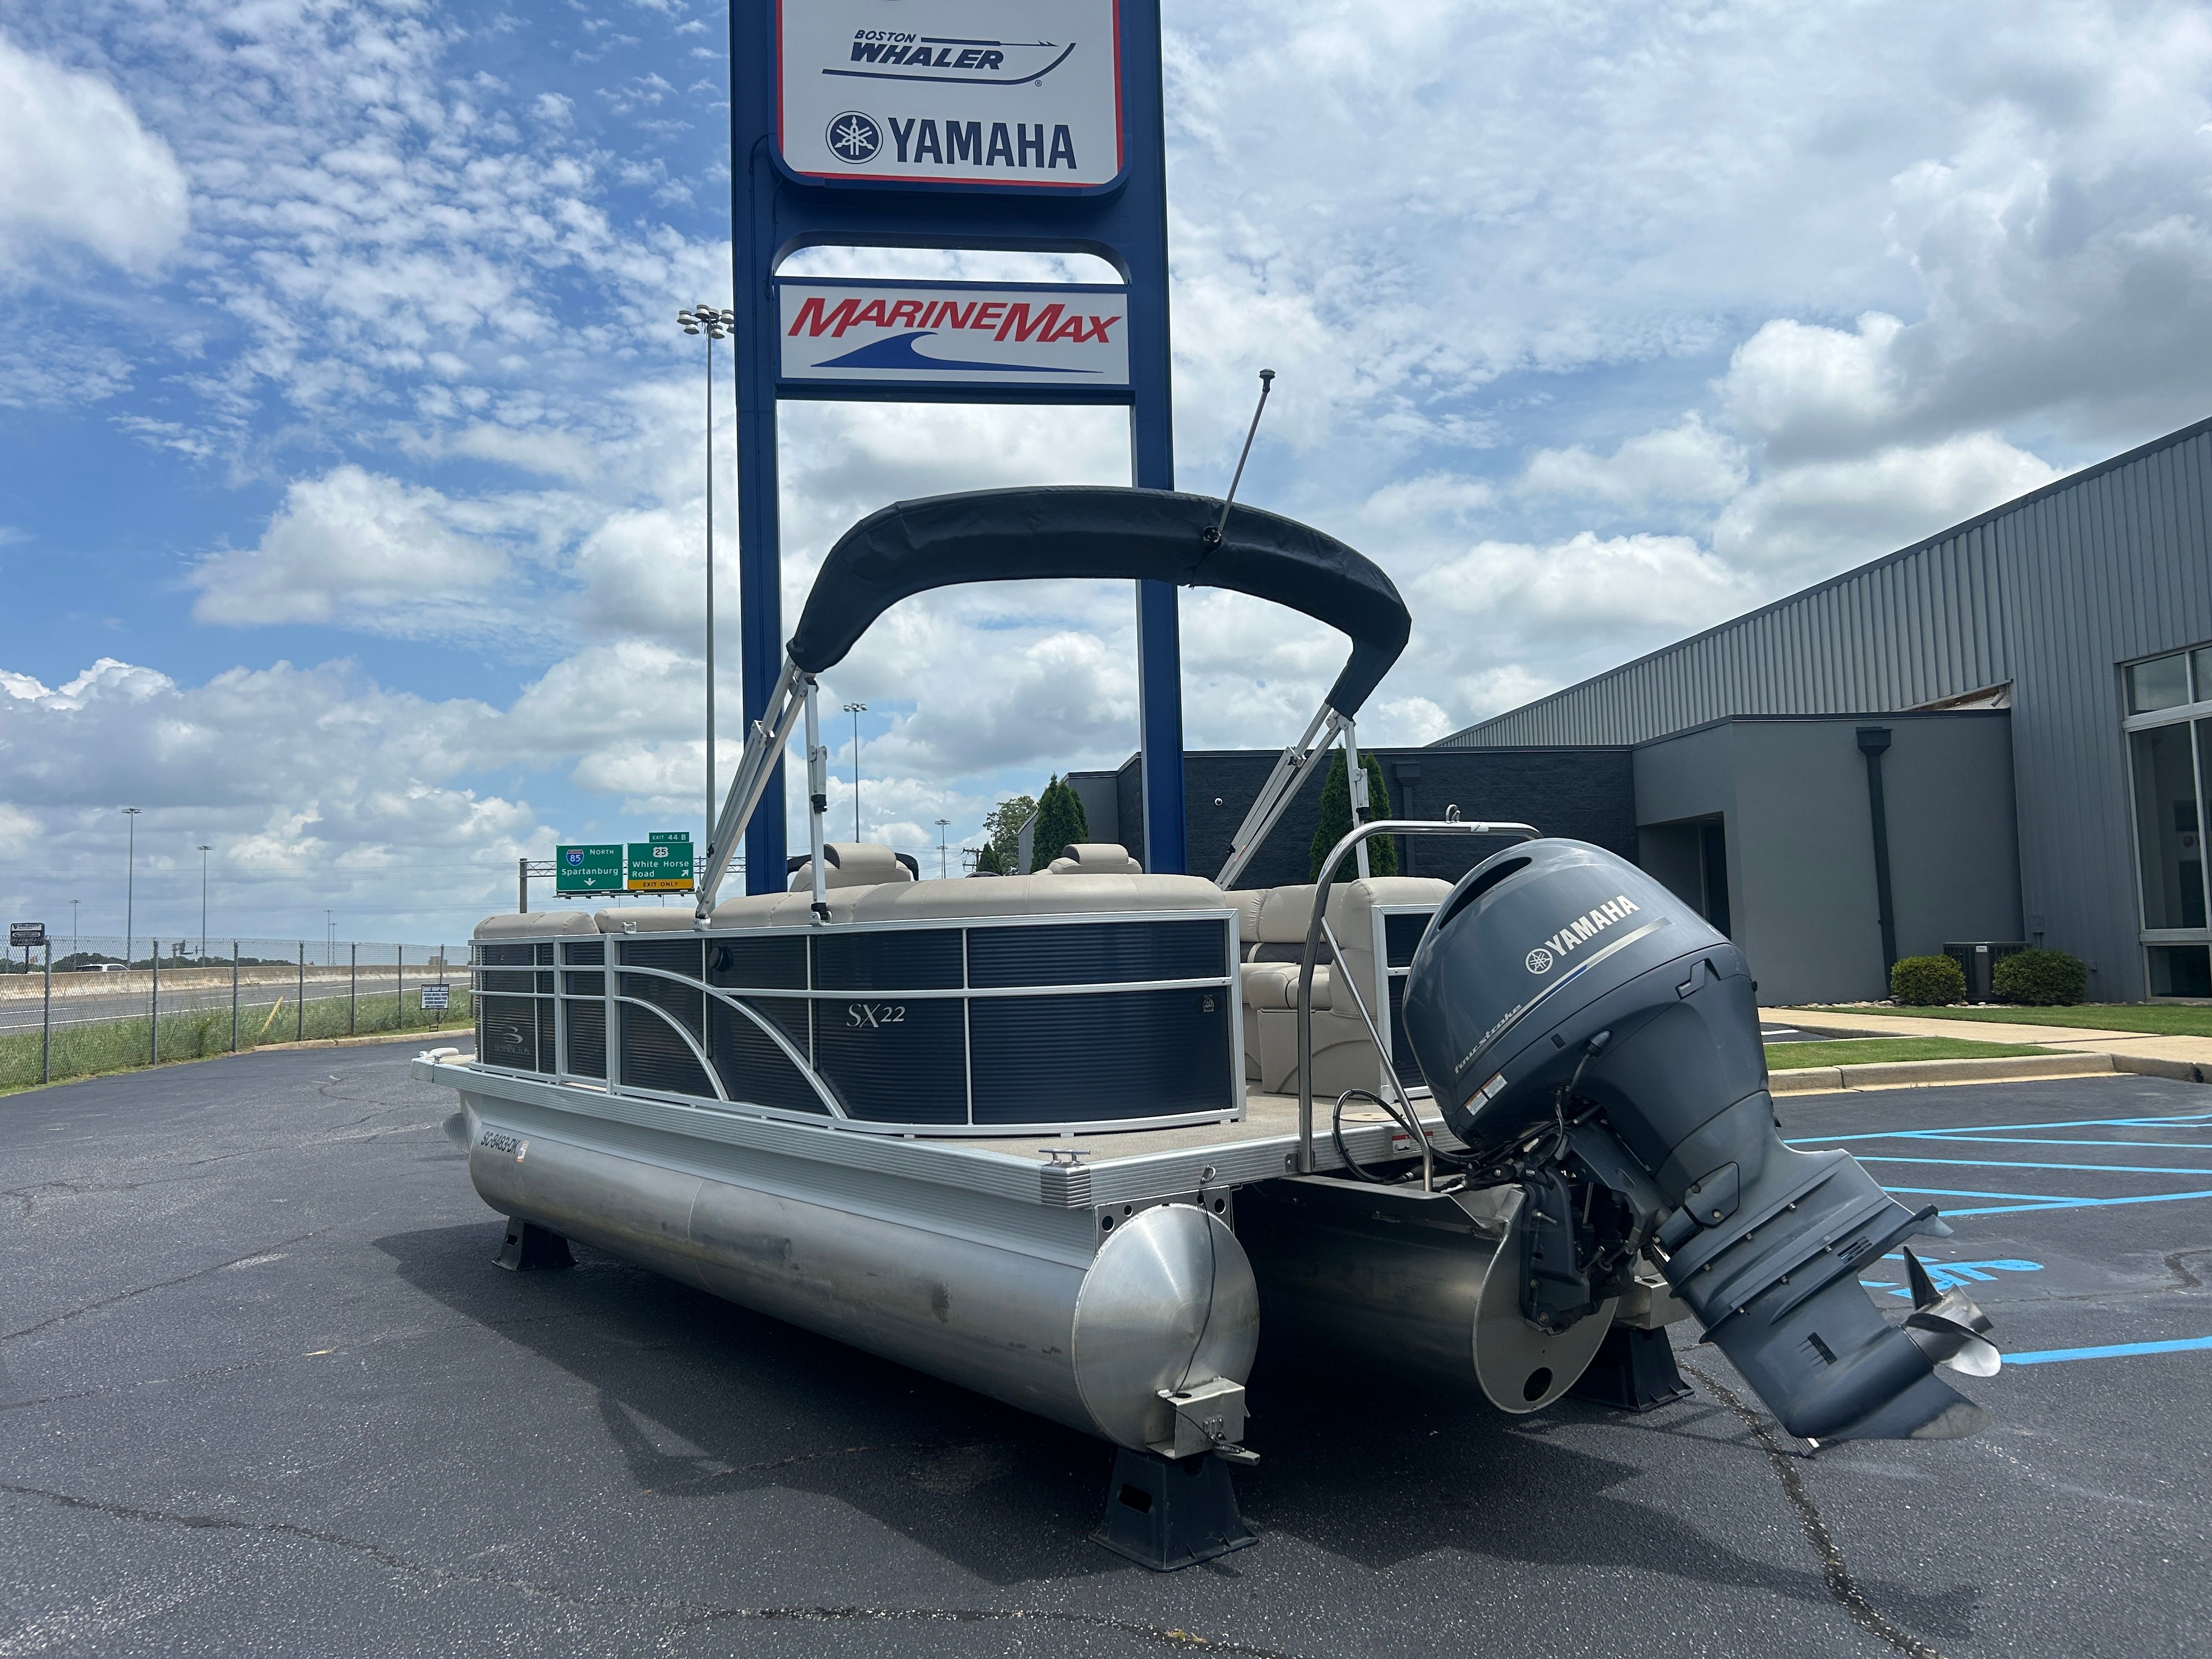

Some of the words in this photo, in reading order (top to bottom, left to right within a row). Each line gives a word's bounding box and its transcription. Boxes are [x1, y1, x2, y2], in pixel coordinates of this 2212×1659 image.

[854, 30, 917, 43] BOSTON
[850, 42, 1004, 70] WHALER
[888, 117, 1077, 170] YAMAHA
[561, 867, 618, 876] Spartanburg
[1544, 895, 1640, 956] YAMAHA
[481, 1131, 521, 1154] SC-8483-DK
